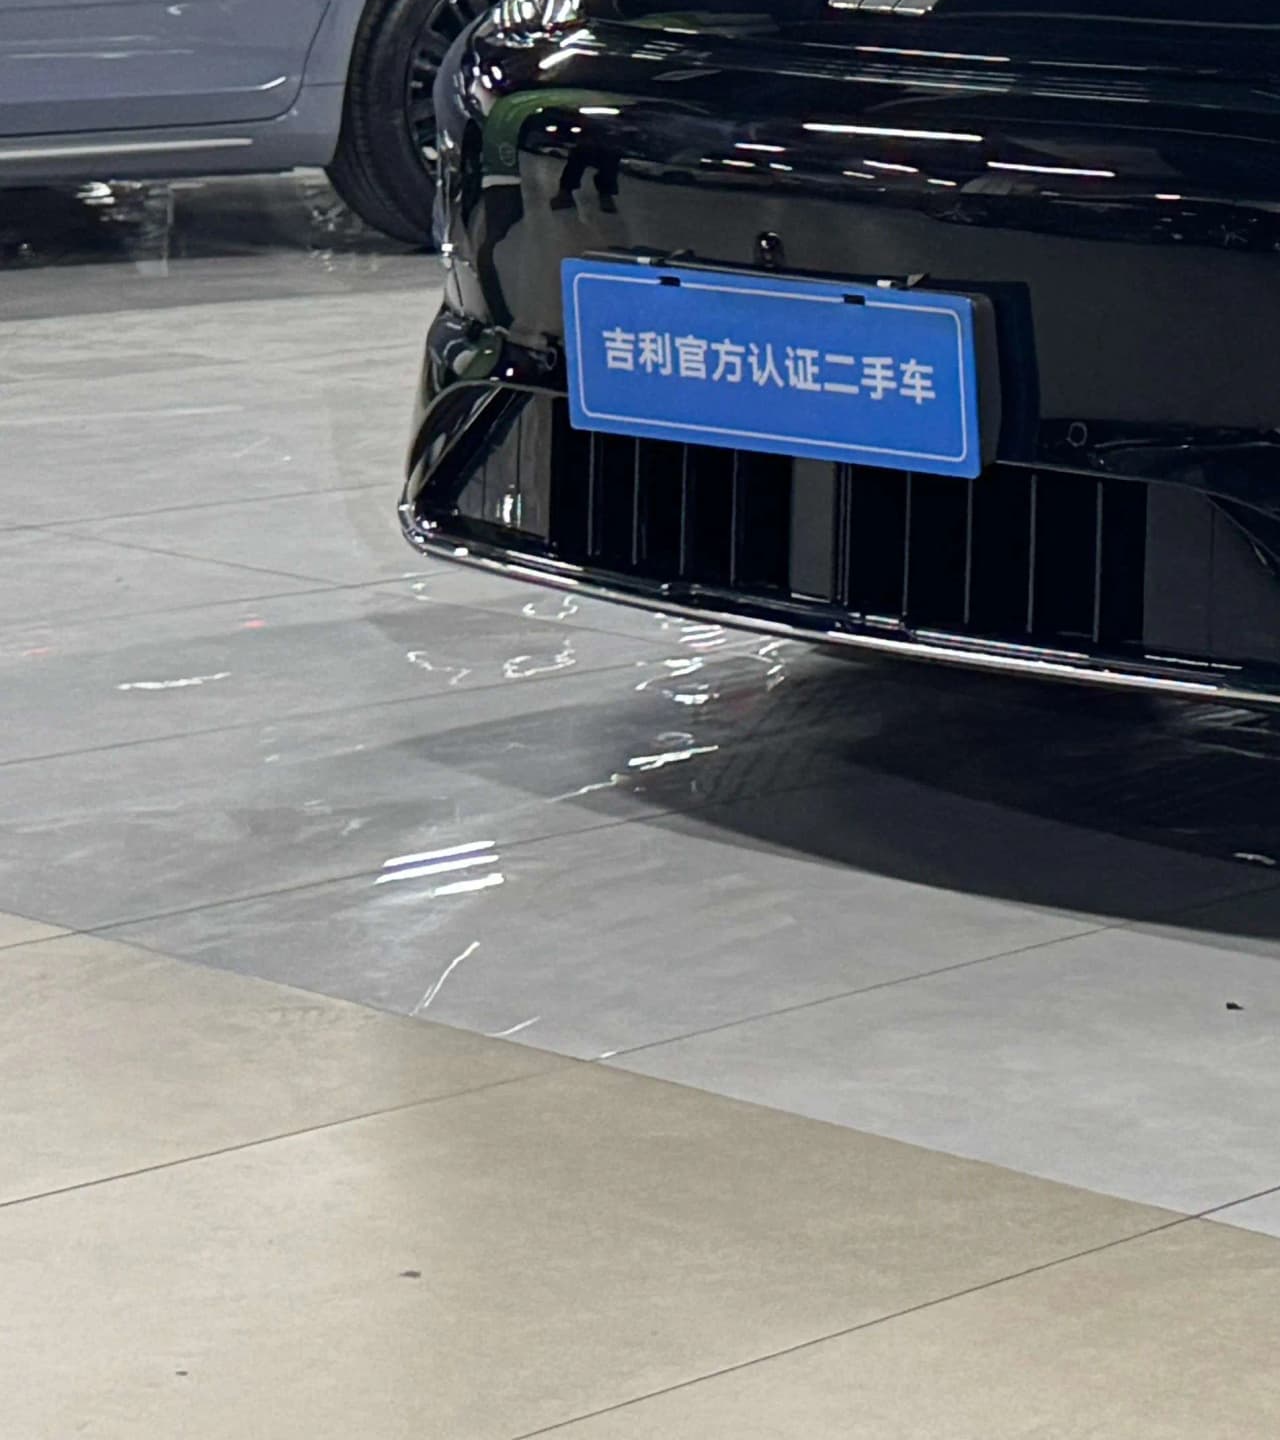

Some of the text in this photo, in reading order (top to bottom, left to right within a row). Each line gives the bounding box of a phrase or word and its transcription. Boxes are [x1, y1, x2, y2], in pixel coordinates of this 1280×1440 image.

[602, 327, 936, 405] 吉利官方认证二手车
